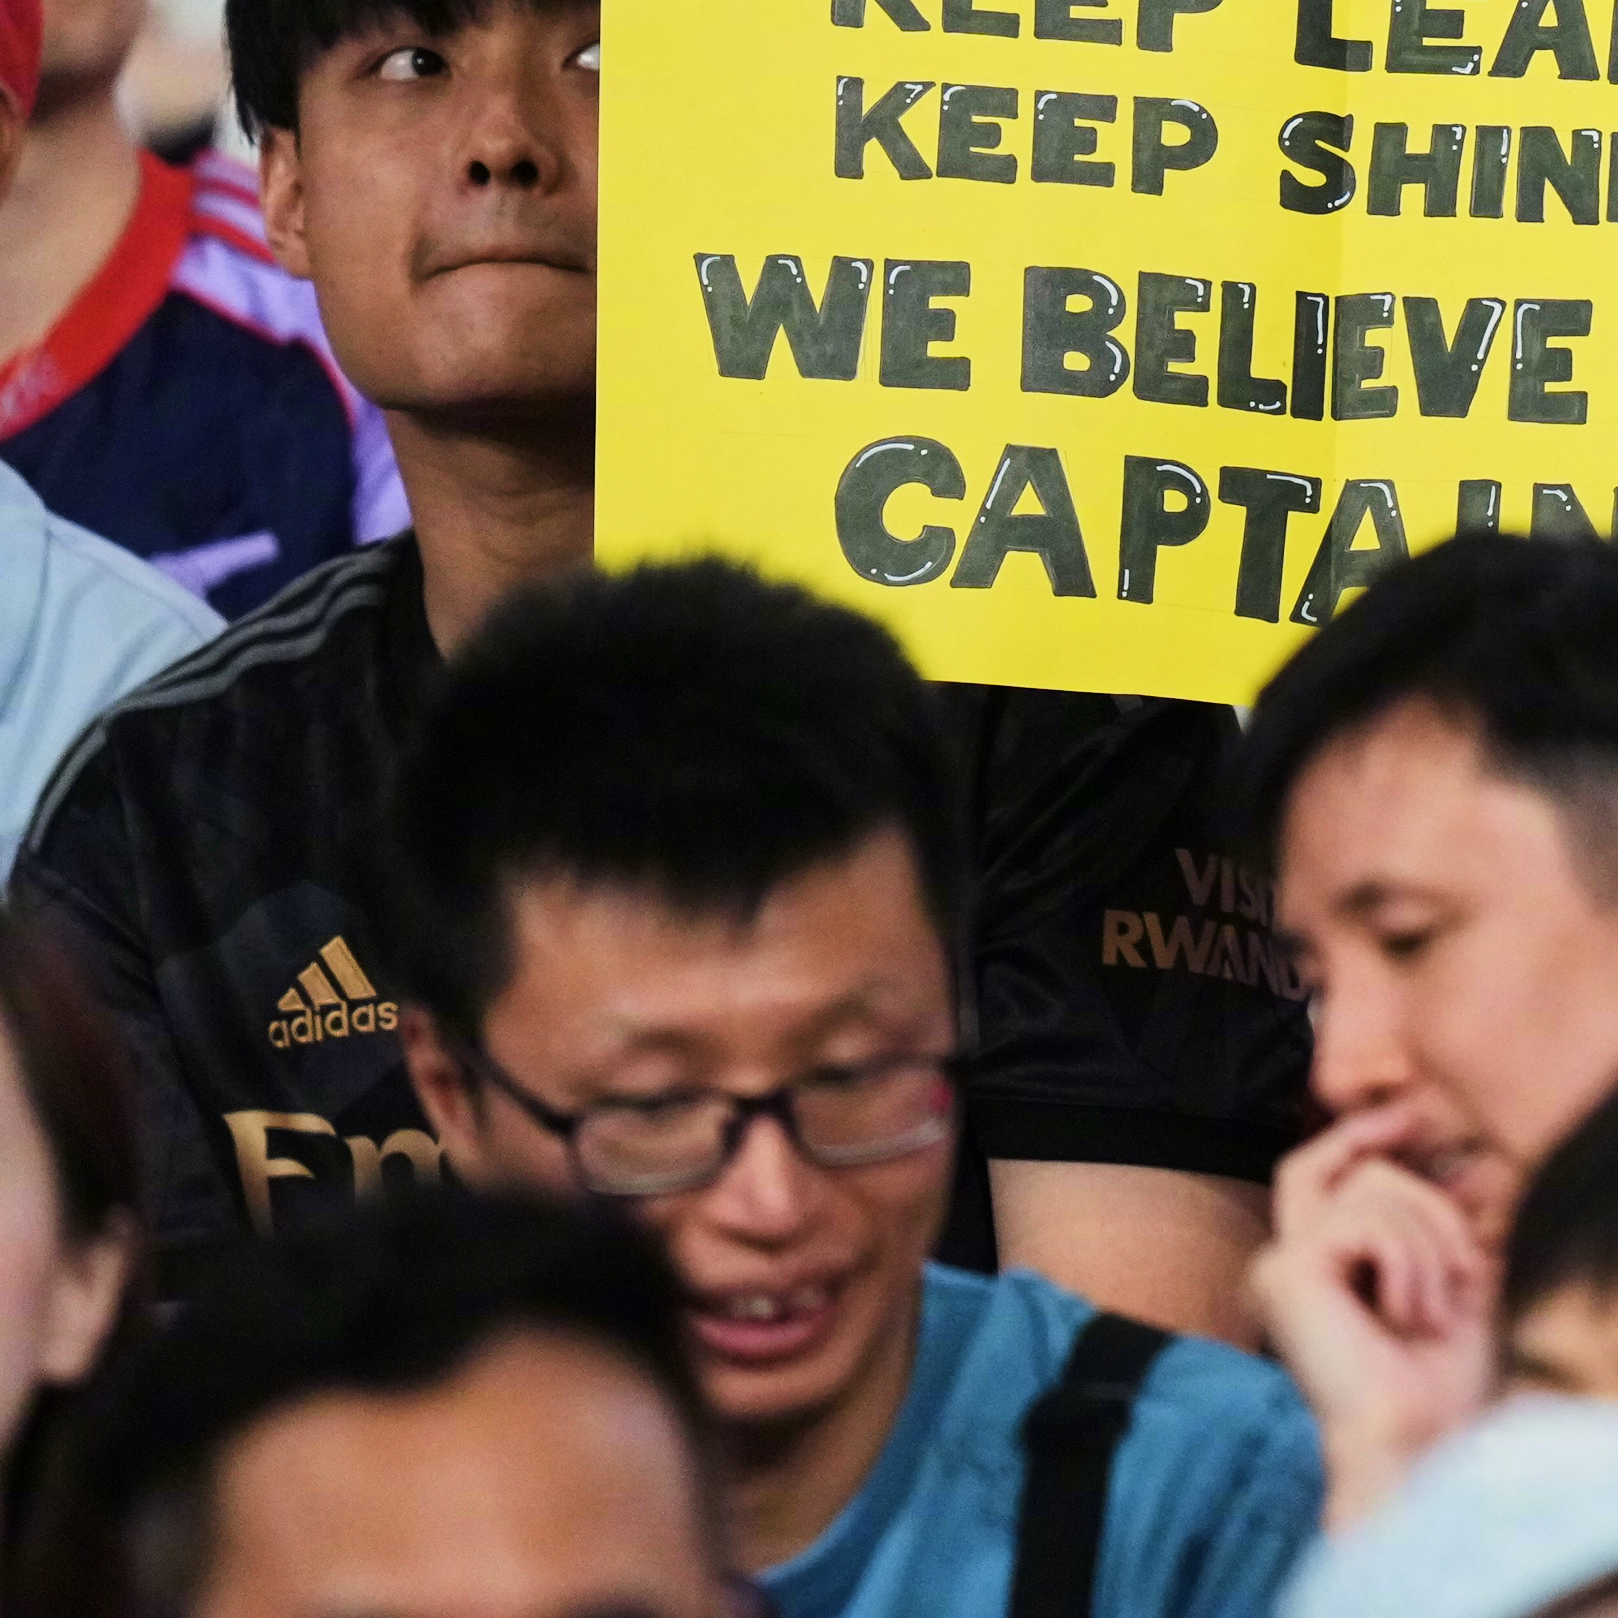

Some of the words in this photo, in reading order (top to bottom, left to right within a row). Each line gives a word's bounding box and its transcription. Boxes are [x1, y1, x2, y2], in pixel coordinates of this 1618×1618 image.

[834, 75, 1219, 196] KEEP
[693, 252, 971, 392] WE
[1020, 266, 1593, 425] BELIEVE
[268, 1000, 399, 1049] adidas
